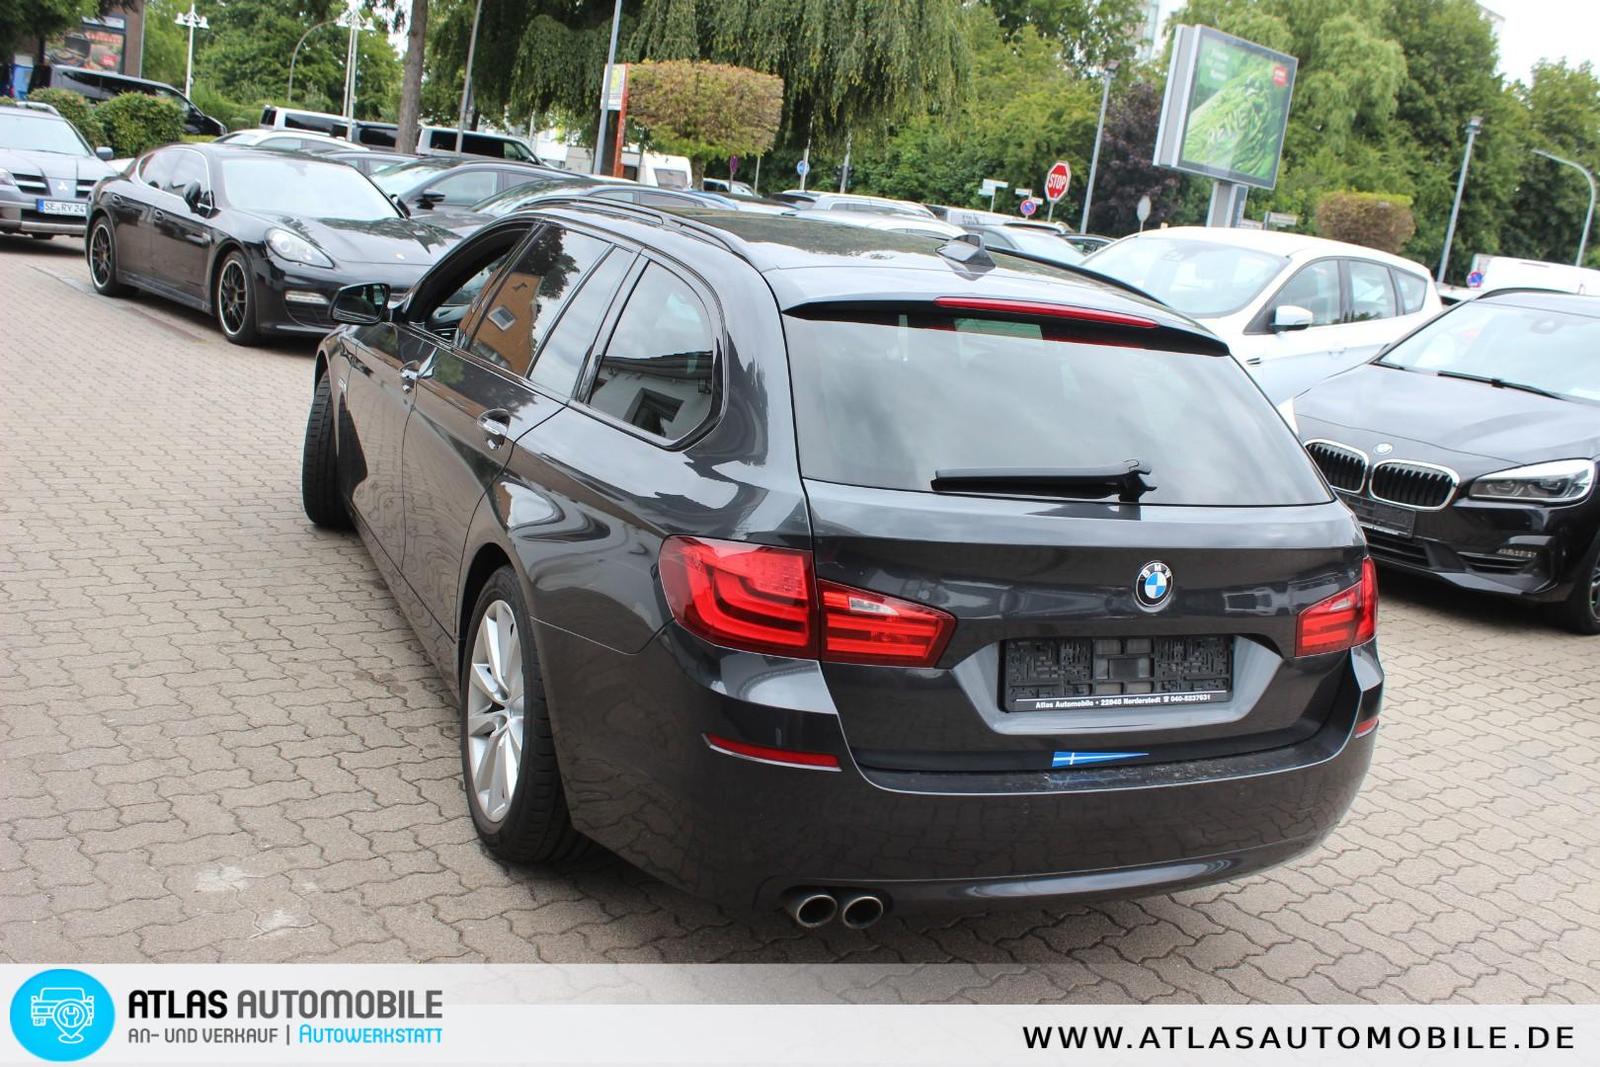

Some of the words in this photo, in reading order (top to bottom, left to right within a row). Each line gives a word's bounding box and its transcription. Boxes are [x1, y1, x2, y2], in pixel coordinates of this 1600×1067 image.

[1048, 173, 1067, 190] STOP
[45, 202, 55, 211] SE
[61, 203, 72, 212] RY
[1142, 564, 1172, 578] BMW
[1035, 701, 1053, 709] Atlas
[1055, 699, 1093, 708] Automobile
[1123, 696, 1161, 705] Norderstedt
